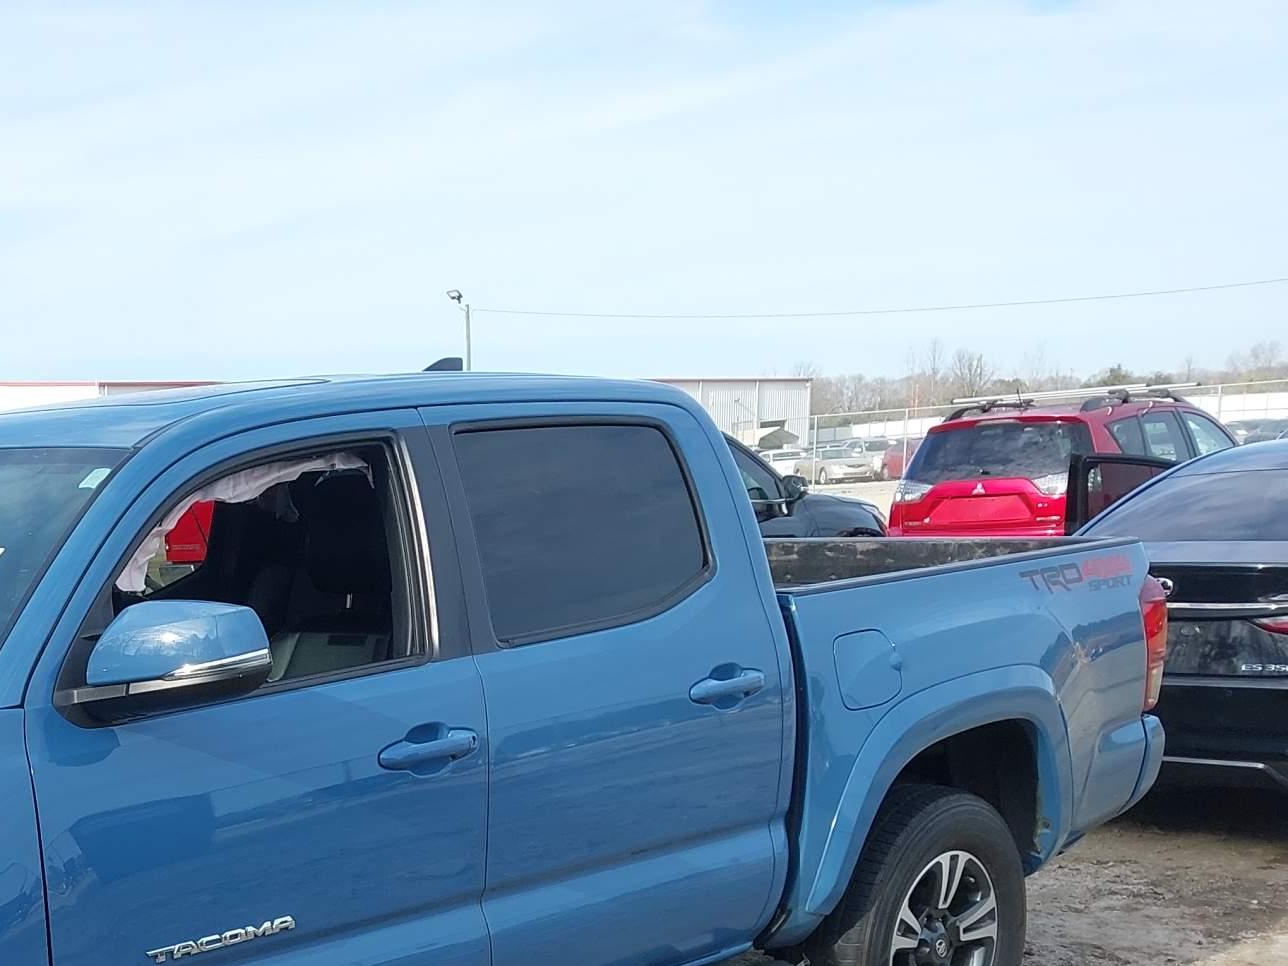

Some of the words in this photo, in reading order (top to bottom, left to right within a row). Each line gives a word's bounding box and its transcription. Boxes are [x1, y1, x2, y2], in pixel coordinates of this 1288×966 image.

[1019, 563, 1083, 594] TRD
[1089, 575, 1132, 592] SPORT
[1241, 663, 1263, 671] ES
[146, 915, 296, 963] TACOMA
